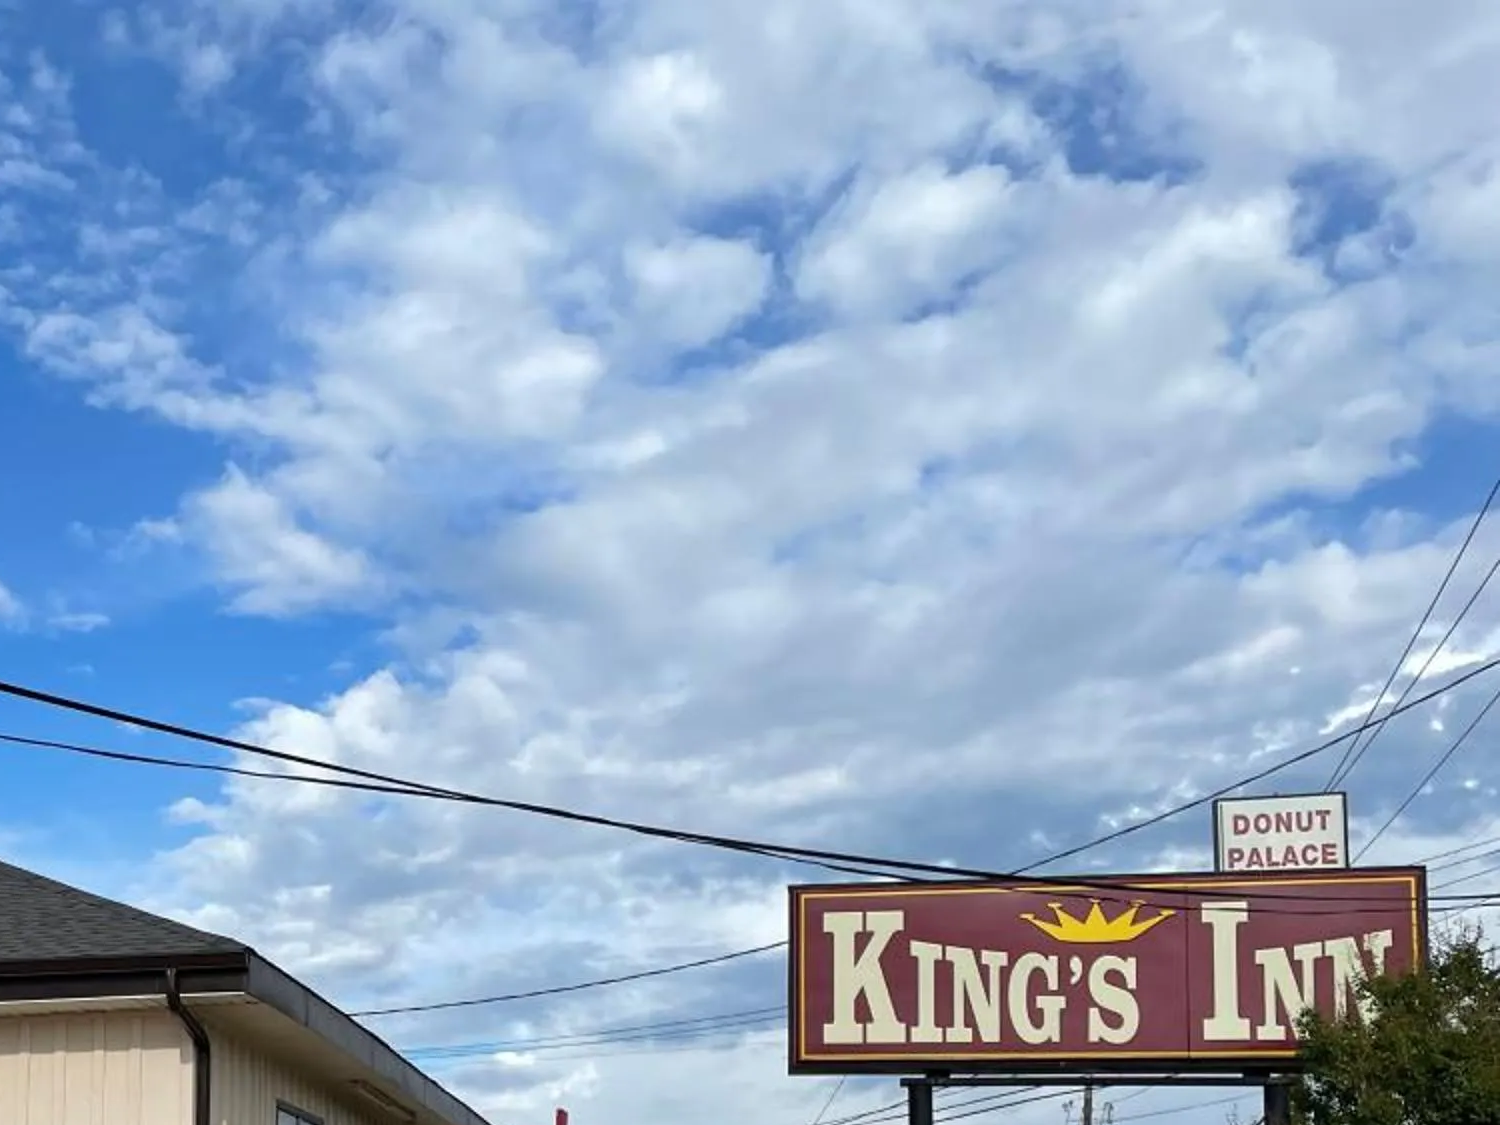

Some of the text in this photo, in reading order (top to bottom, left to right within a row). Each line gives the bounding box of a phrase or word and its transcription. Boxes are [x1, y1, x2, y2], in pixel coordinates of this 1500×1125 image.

[1232, 810, 1331, 835] DONUT
[1227, 843, 1338, 868] PALACE
[823, 901, 1393, 1044] KING'S INN
